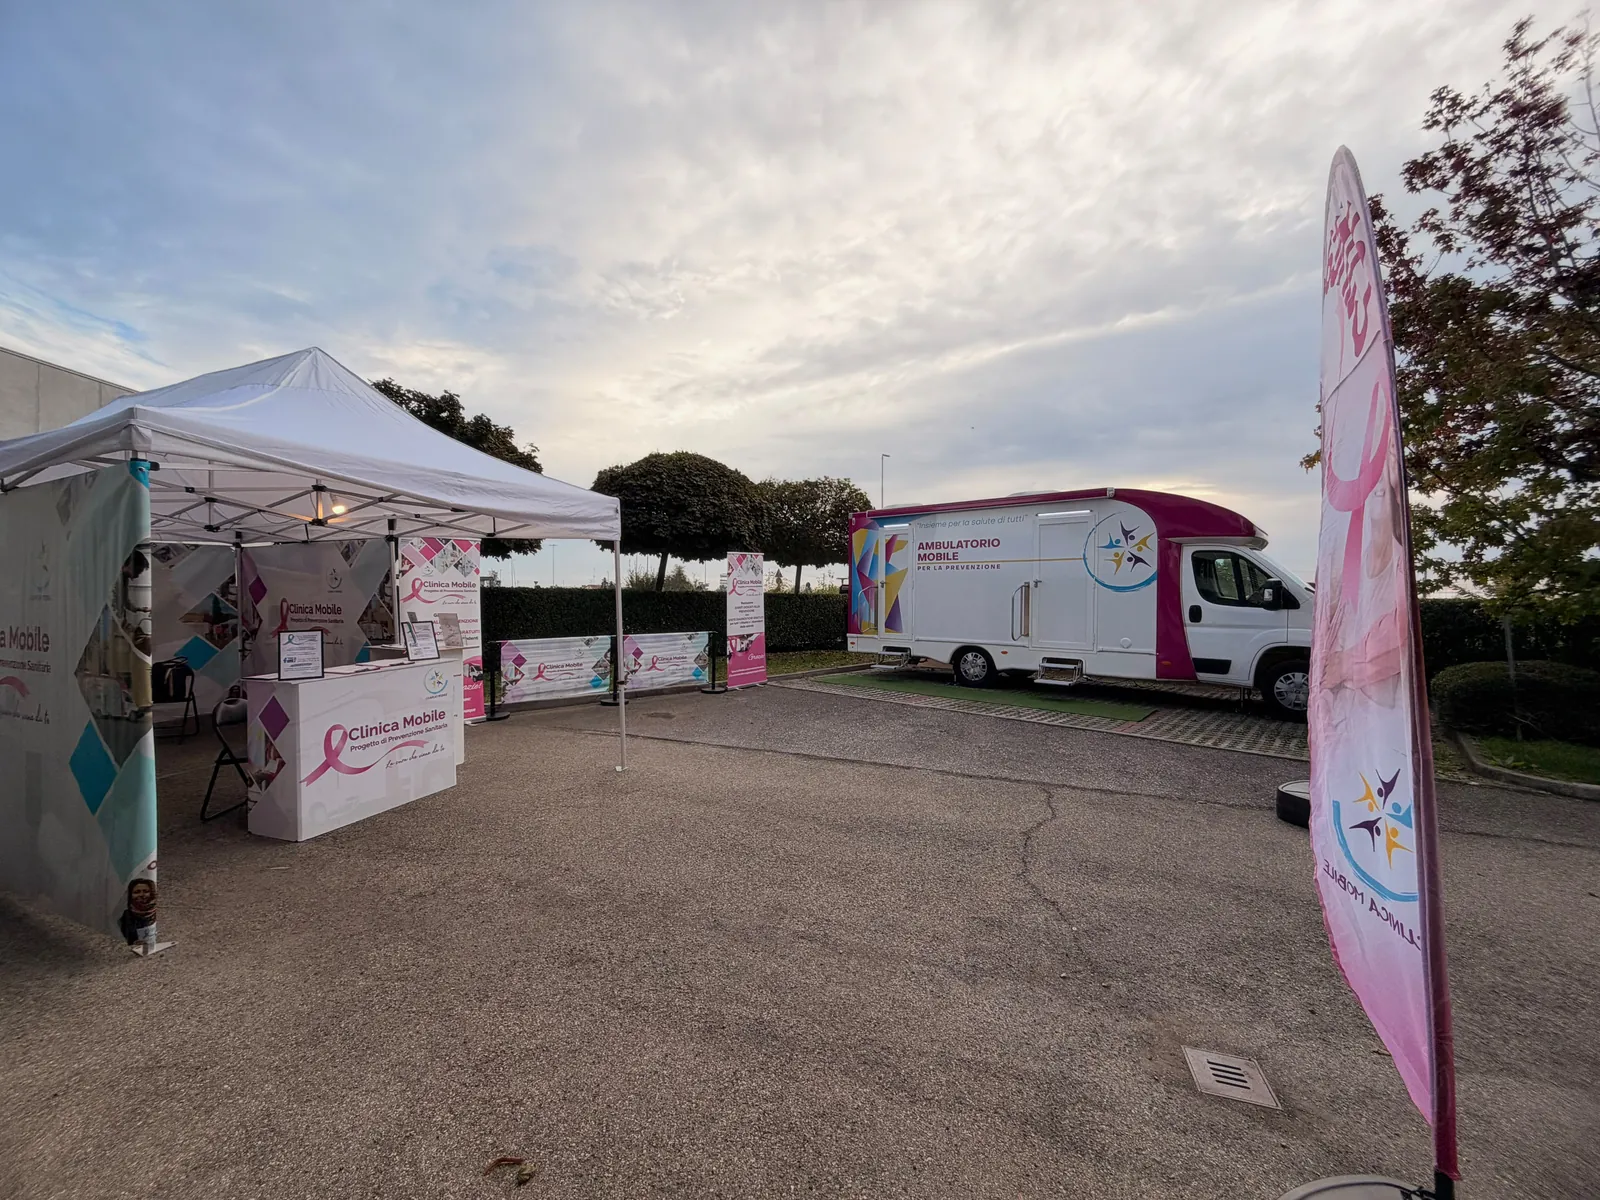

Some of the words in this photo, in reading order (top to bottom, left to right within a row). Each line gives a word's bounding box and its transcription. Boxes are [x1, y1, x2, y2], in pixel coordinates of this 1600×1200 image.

[971, 517, 996, 526] salute
[998, 516, 1006, 524] di
[917, 538, 1000, 550] AMBULATORIO
[917, 552, 959, 561] MOBILE
[289, 604, 313, 614] Clinica
[315, 604, 342, 615] Mobile
[9, 625, 50, 652] Mobile
[349, 720, 399, 741] Clinica
[403, 709, 446, 729] Mobile
[350, 740, 380, 752] Progetto
[380, 736, 388, 744] di
[388, 729, 424, 742] Prevenzione
[425, 723, 448, 734] Sanitaria
